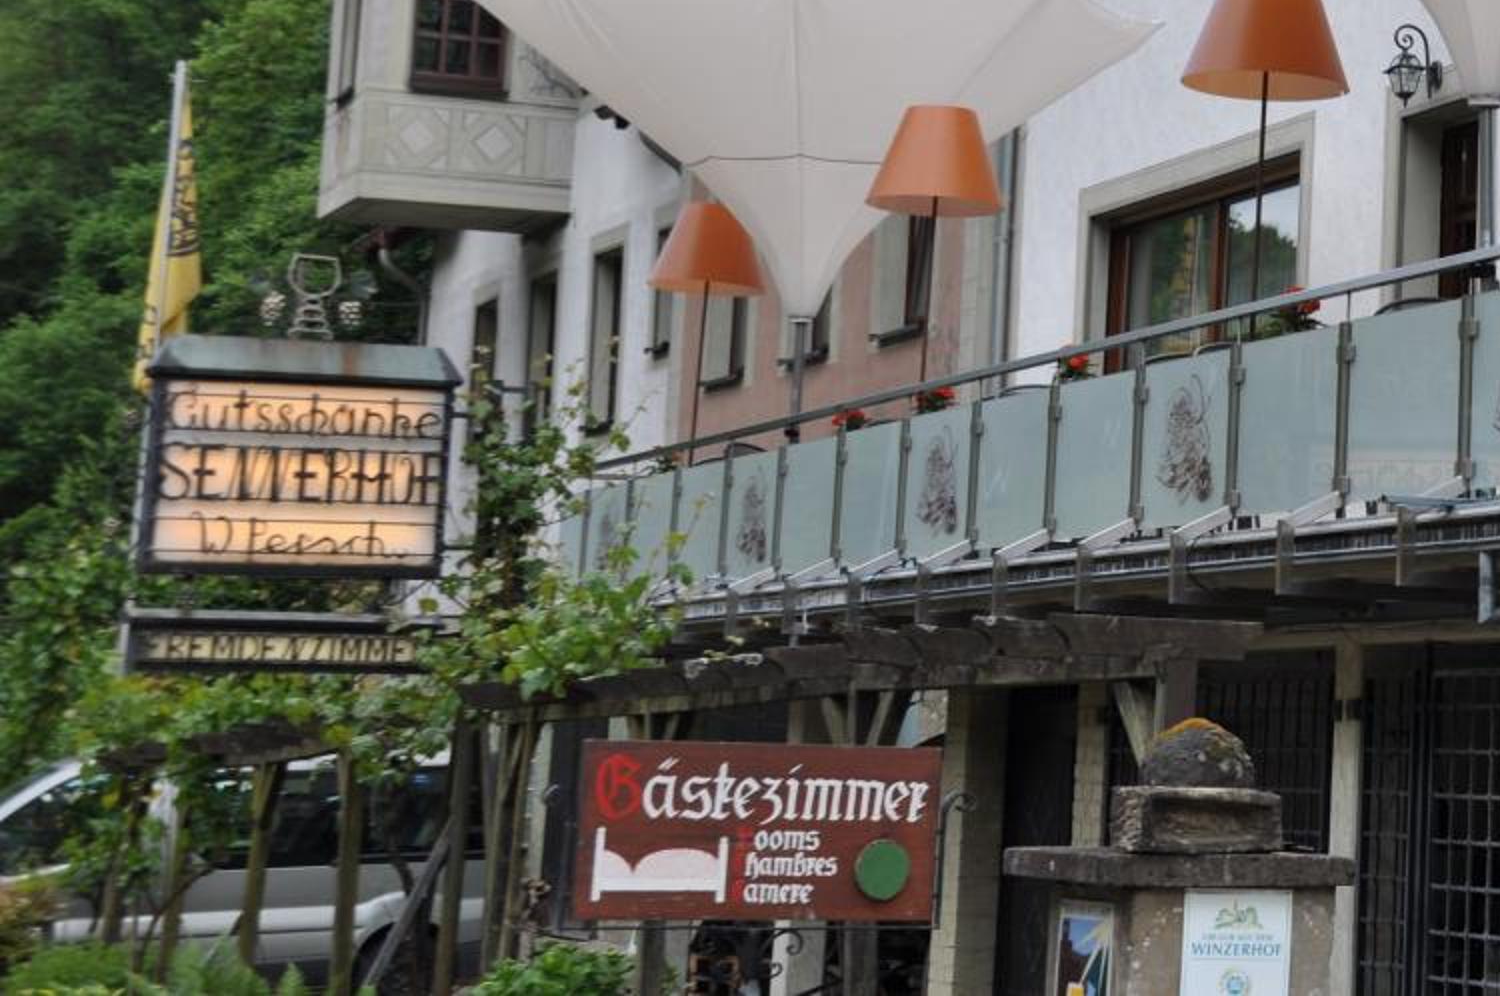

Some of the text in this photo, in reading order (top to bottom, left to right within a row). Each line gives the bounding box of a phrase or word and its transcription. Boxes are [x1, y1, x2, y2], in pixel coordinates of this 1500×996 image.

[143, 630, 416, 664] FREMDENZIMME
[595, 752, 929, 825] Gästezimmer
[1191, 941, 1281, 957] WINZERHOF
